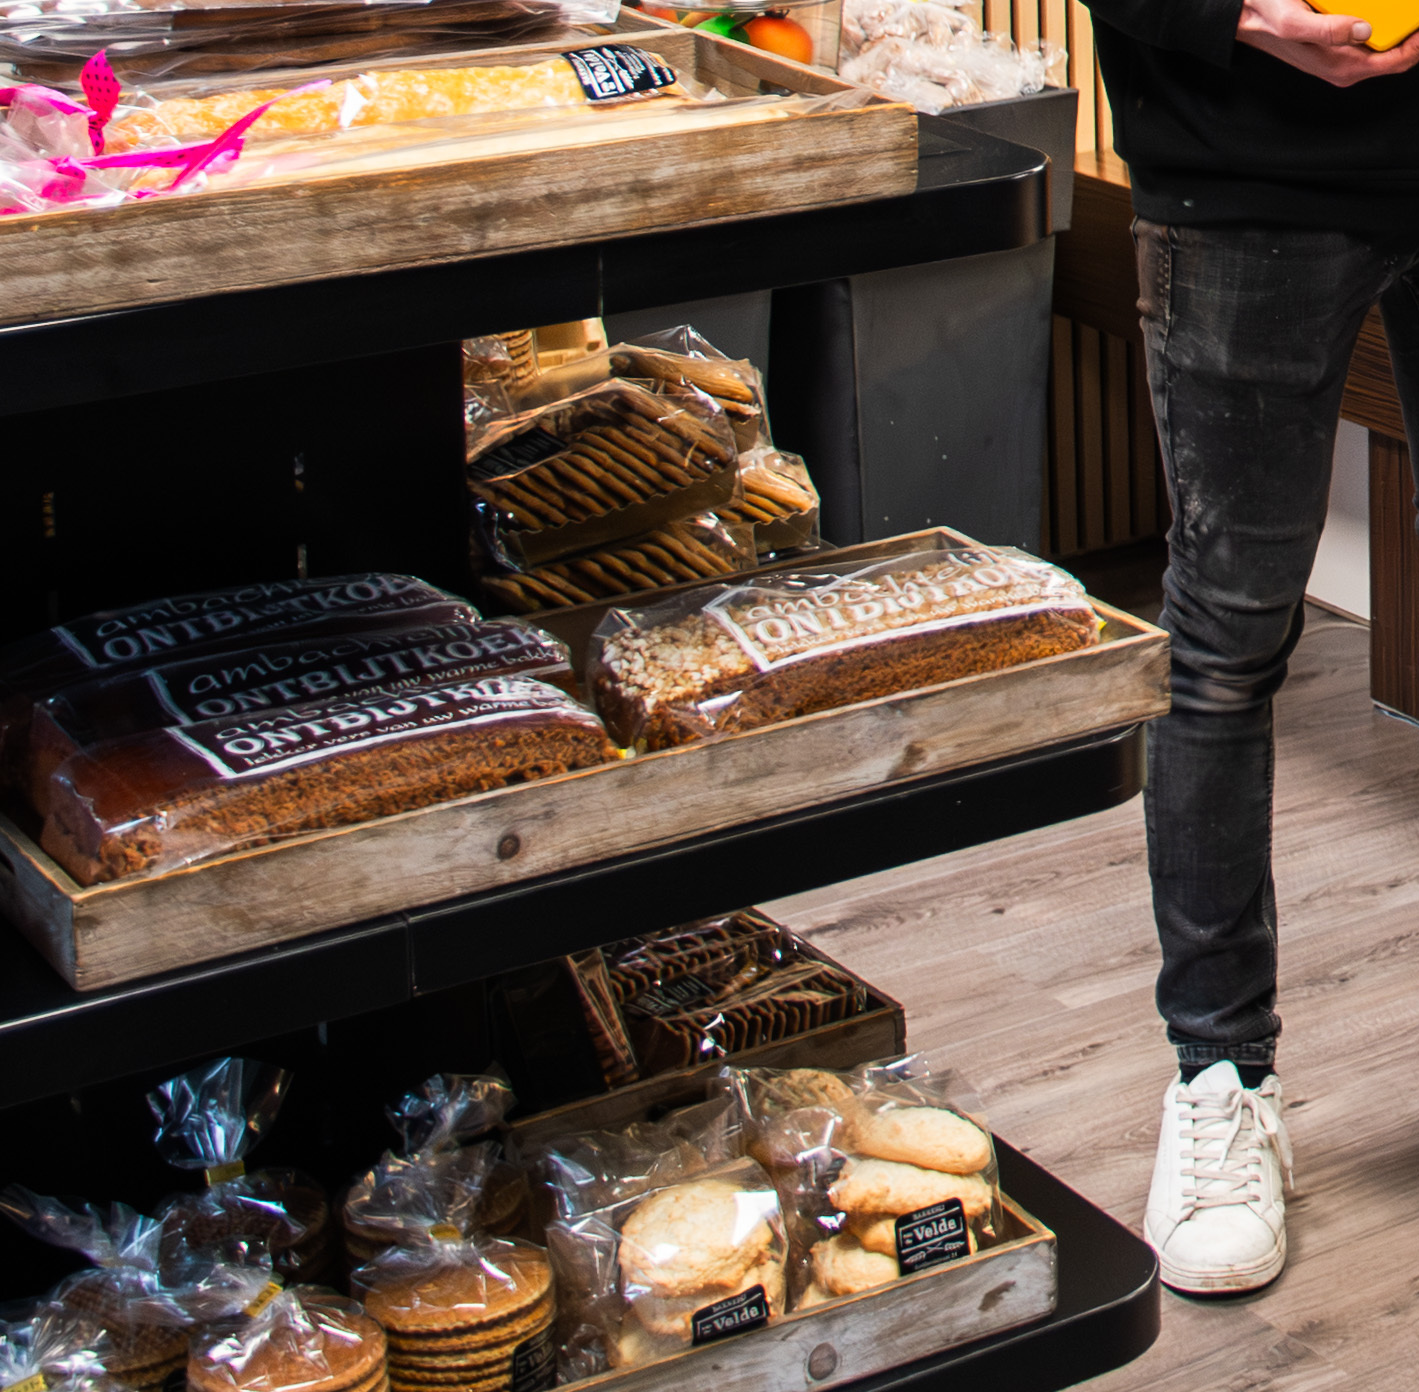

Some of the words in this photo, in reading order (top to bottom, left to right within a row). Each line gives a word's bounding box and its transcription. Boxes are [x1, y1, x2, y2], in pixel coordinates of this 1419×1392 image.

[421, 710, 455, 726] uw
[913, 1215, 958, 1243] Velde
[712, 1304, 760, 1332] Velde
